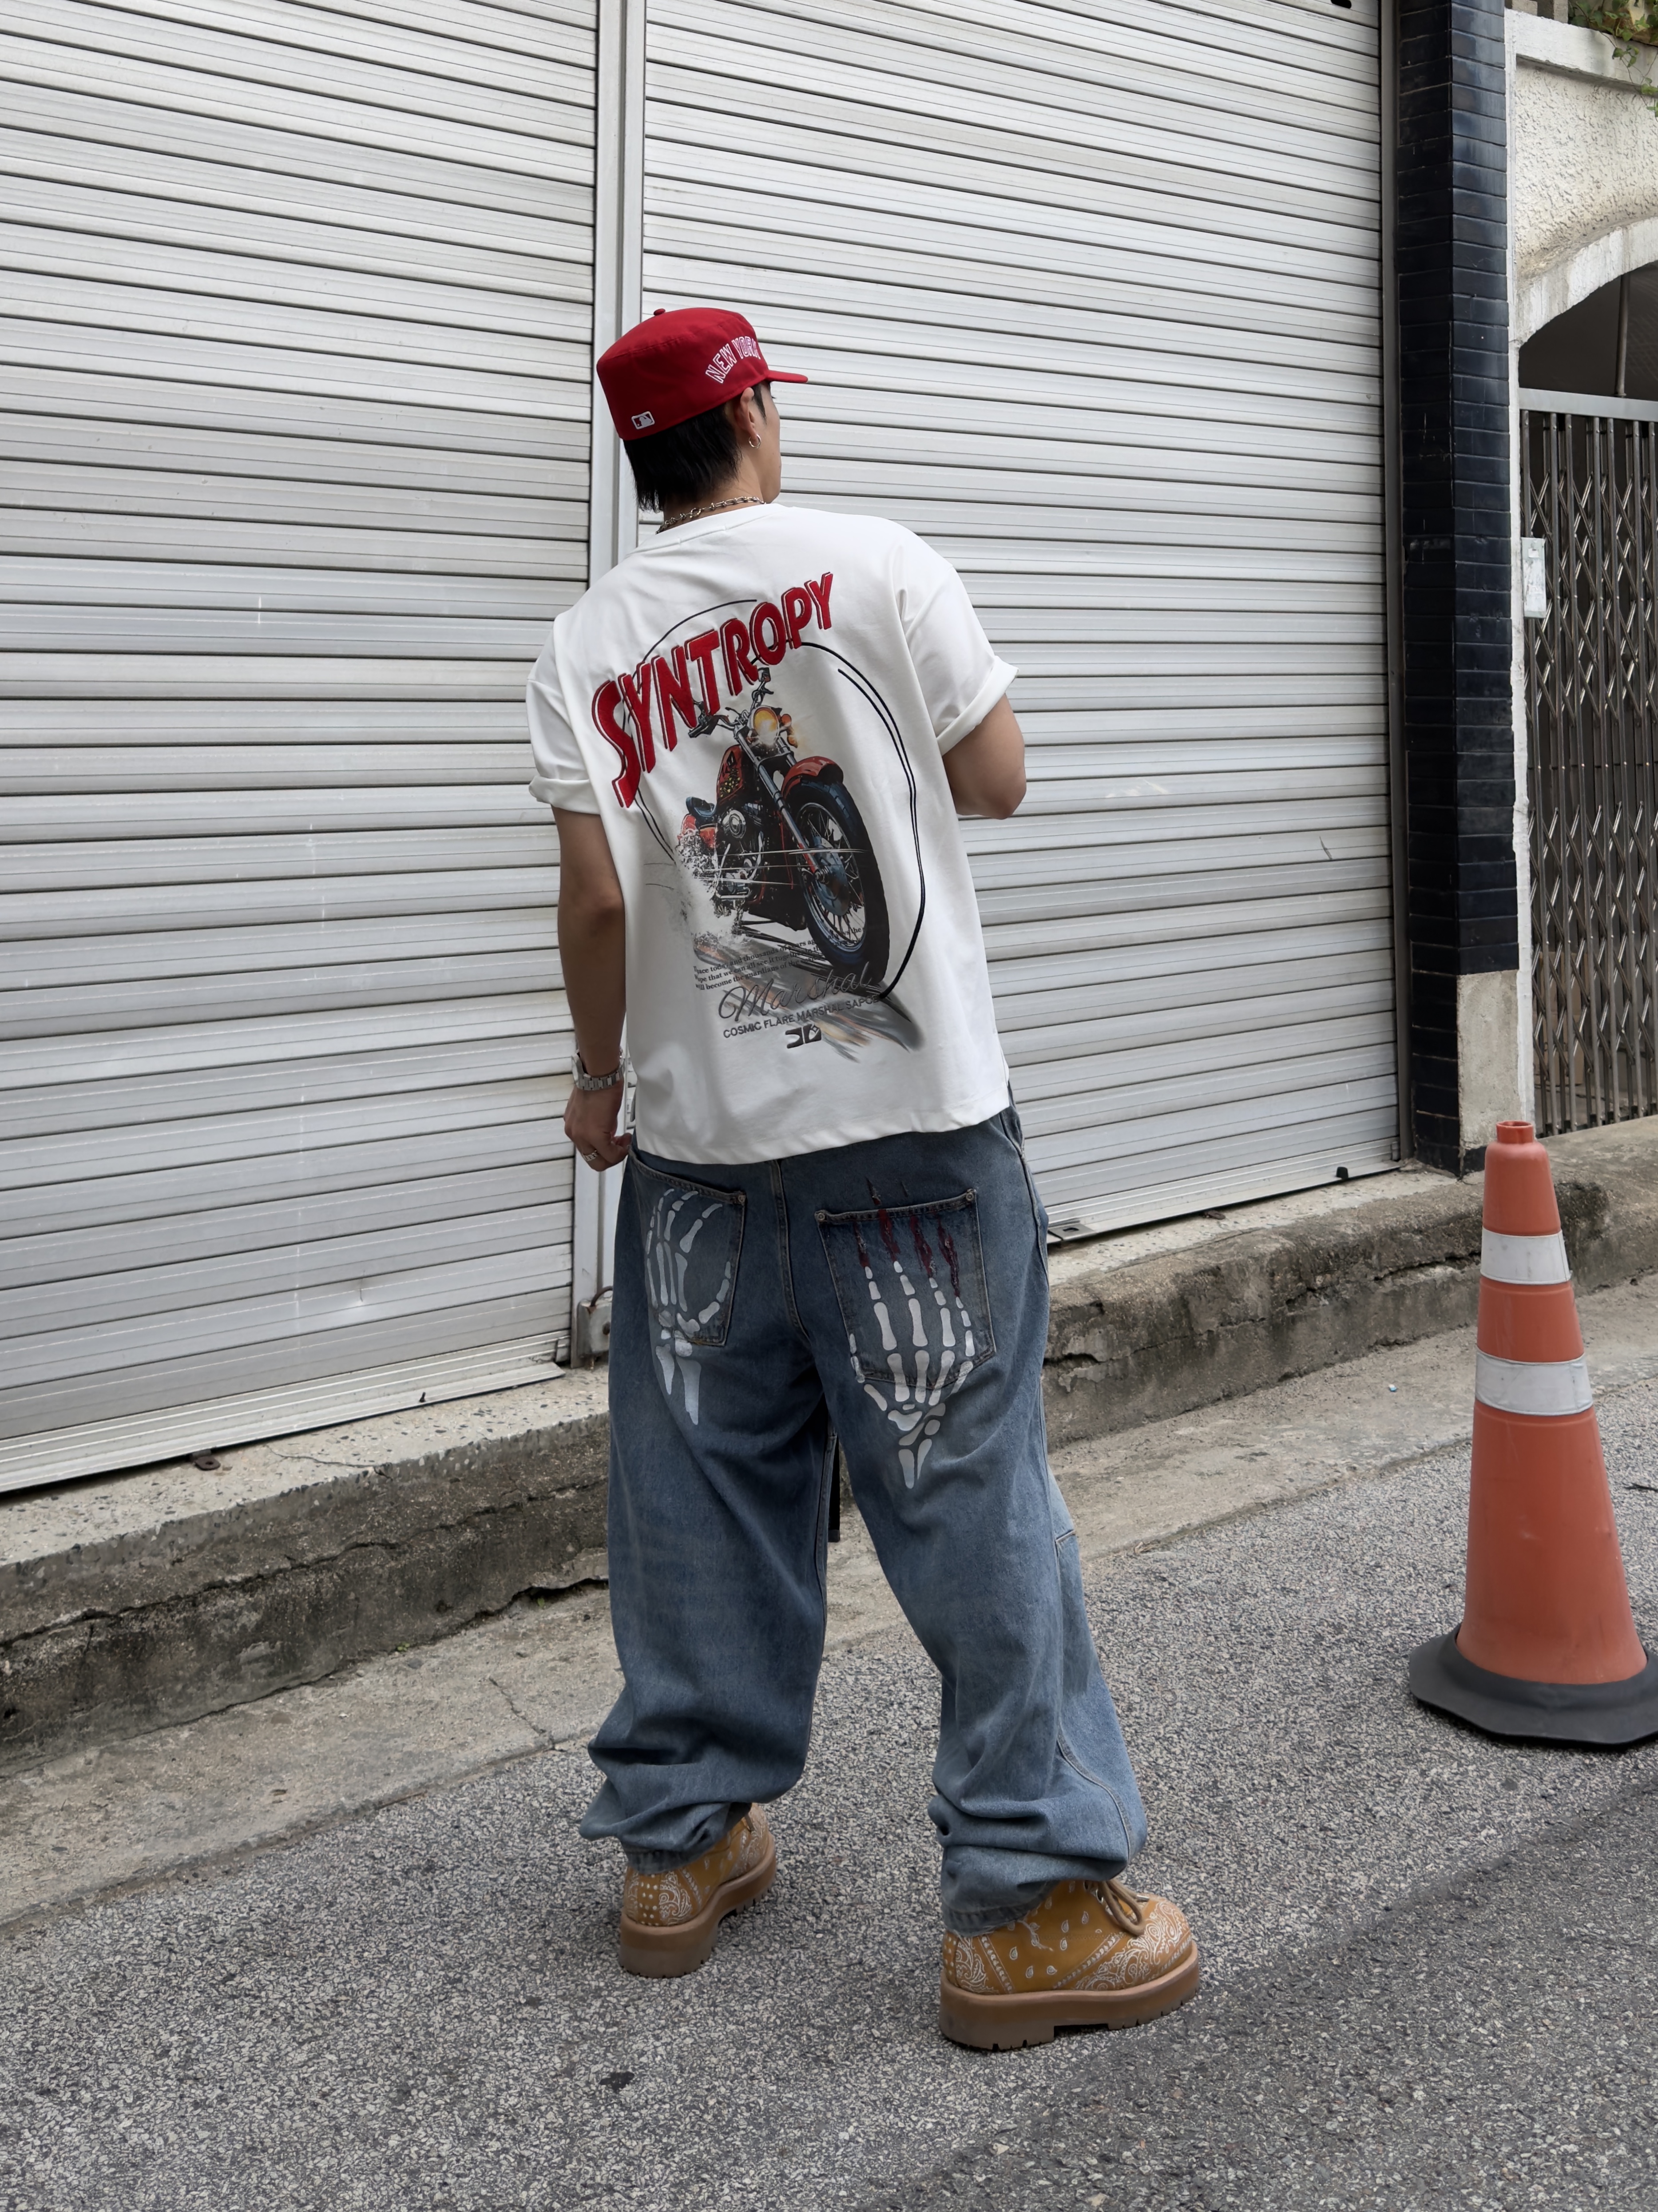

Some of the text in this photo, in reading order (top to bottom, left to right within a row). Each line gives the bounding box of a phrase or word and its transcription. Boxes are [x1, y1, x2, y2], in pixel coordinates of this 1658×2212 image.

[705, 336, 761, 384] NEW YORK
[592, 572, 833, 808] SYNTROPY
[705, 979, 733, 990] become
[745, 965, 779, 980] guardians
[730, 956, 742, 965] and
[743, 948, 779, 961] thousands
[718, 961, 872, 1022] Marshal
[722, 1021, 762, 1039] COSMIC
[763, 1014, 795, 1029] FLARE
[796, 1003, 844, 1021] MARSHAL
